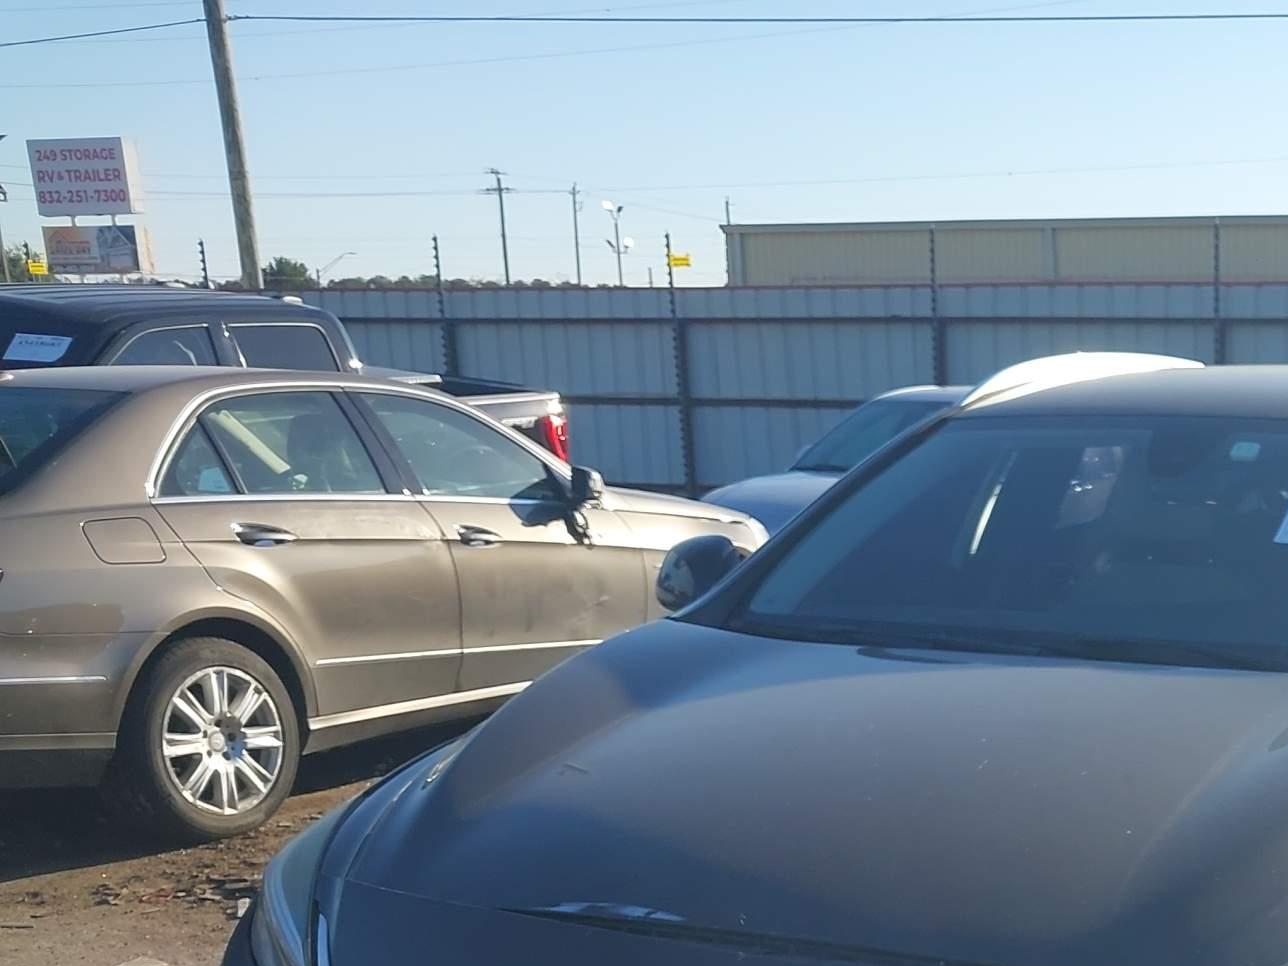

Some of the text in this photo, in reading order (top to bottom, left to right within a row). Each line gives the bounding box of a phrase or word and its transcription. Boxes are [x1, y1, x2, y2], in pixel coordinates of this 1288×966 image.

[35, 148, 116, 162] 249 STORAGE
[37, 170, 56, 183] RV
[65, 168, 121, 183] TRAILER
[38, 189, 126, 204] 832-251-7300
